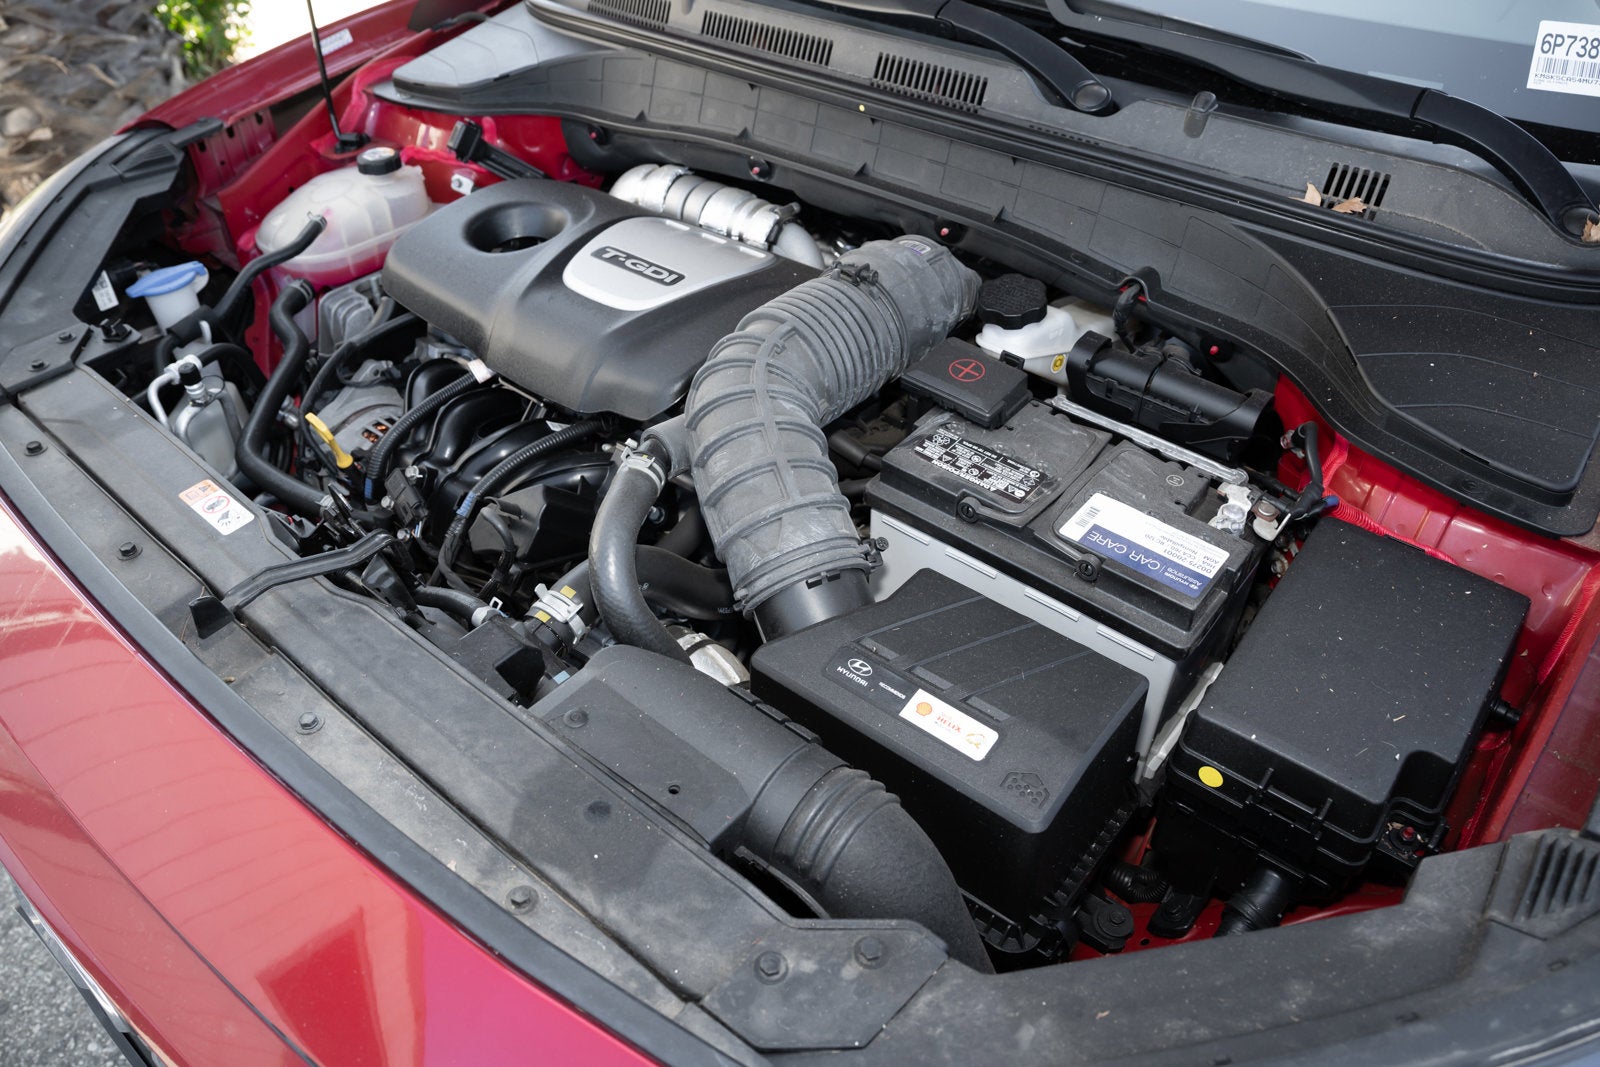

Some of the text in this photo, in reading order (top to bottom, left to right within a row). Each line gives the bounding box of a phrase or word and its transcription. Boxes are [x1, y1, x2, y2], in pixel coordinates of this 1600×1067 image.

[1534, 73, 1600, 85] KM8K5CA54MU7
[1085, 529, 1129, 555] CARE
[1126, 549, 1162, 571] CAR
[836, 666, 869, 687] HYUNDAI
[936, 716, 962, 733] HELIX
